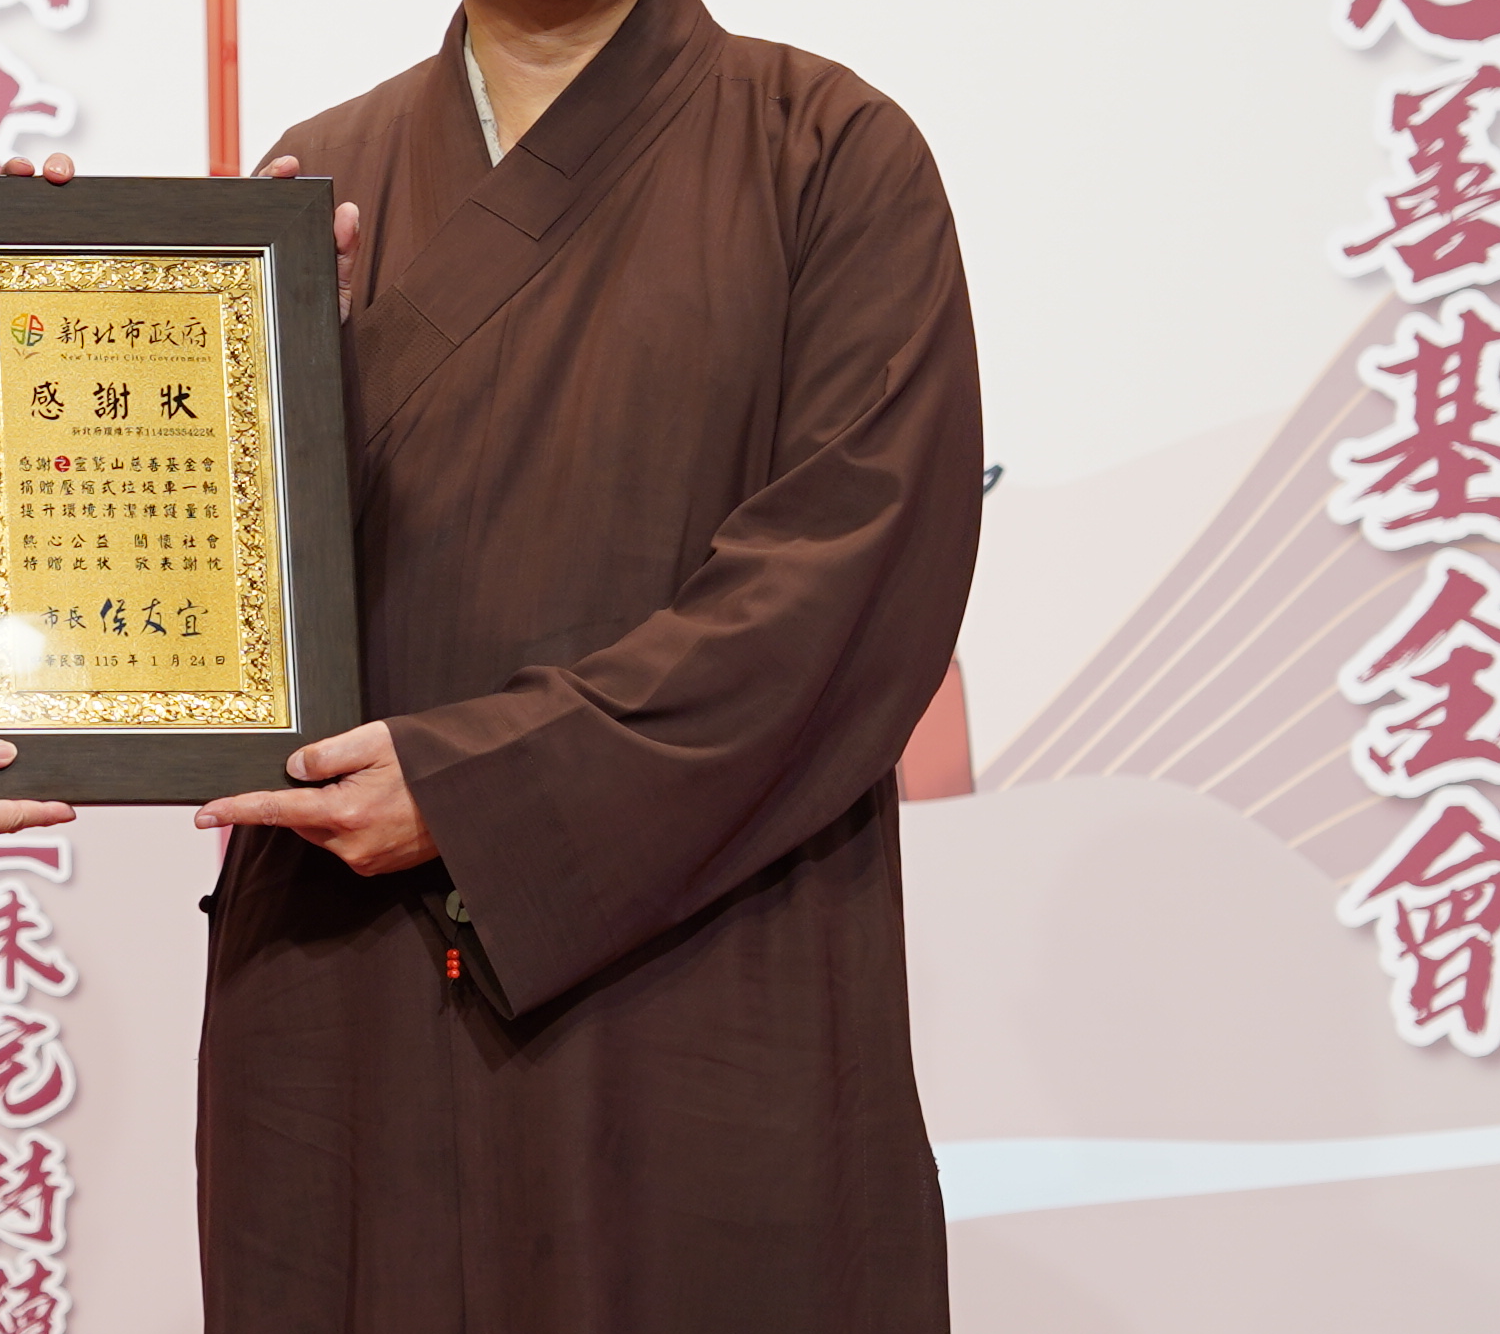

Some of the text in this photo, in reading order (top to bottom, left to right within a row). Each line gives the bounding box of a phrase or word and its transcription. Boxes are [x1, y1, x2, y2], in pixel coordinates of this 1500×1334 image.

[56, 317, 207, 349] 新北市政府
[61, 353, 212, 364] New Taipei City Government
[40, 597, 208, 637] 市長 侯友宜
